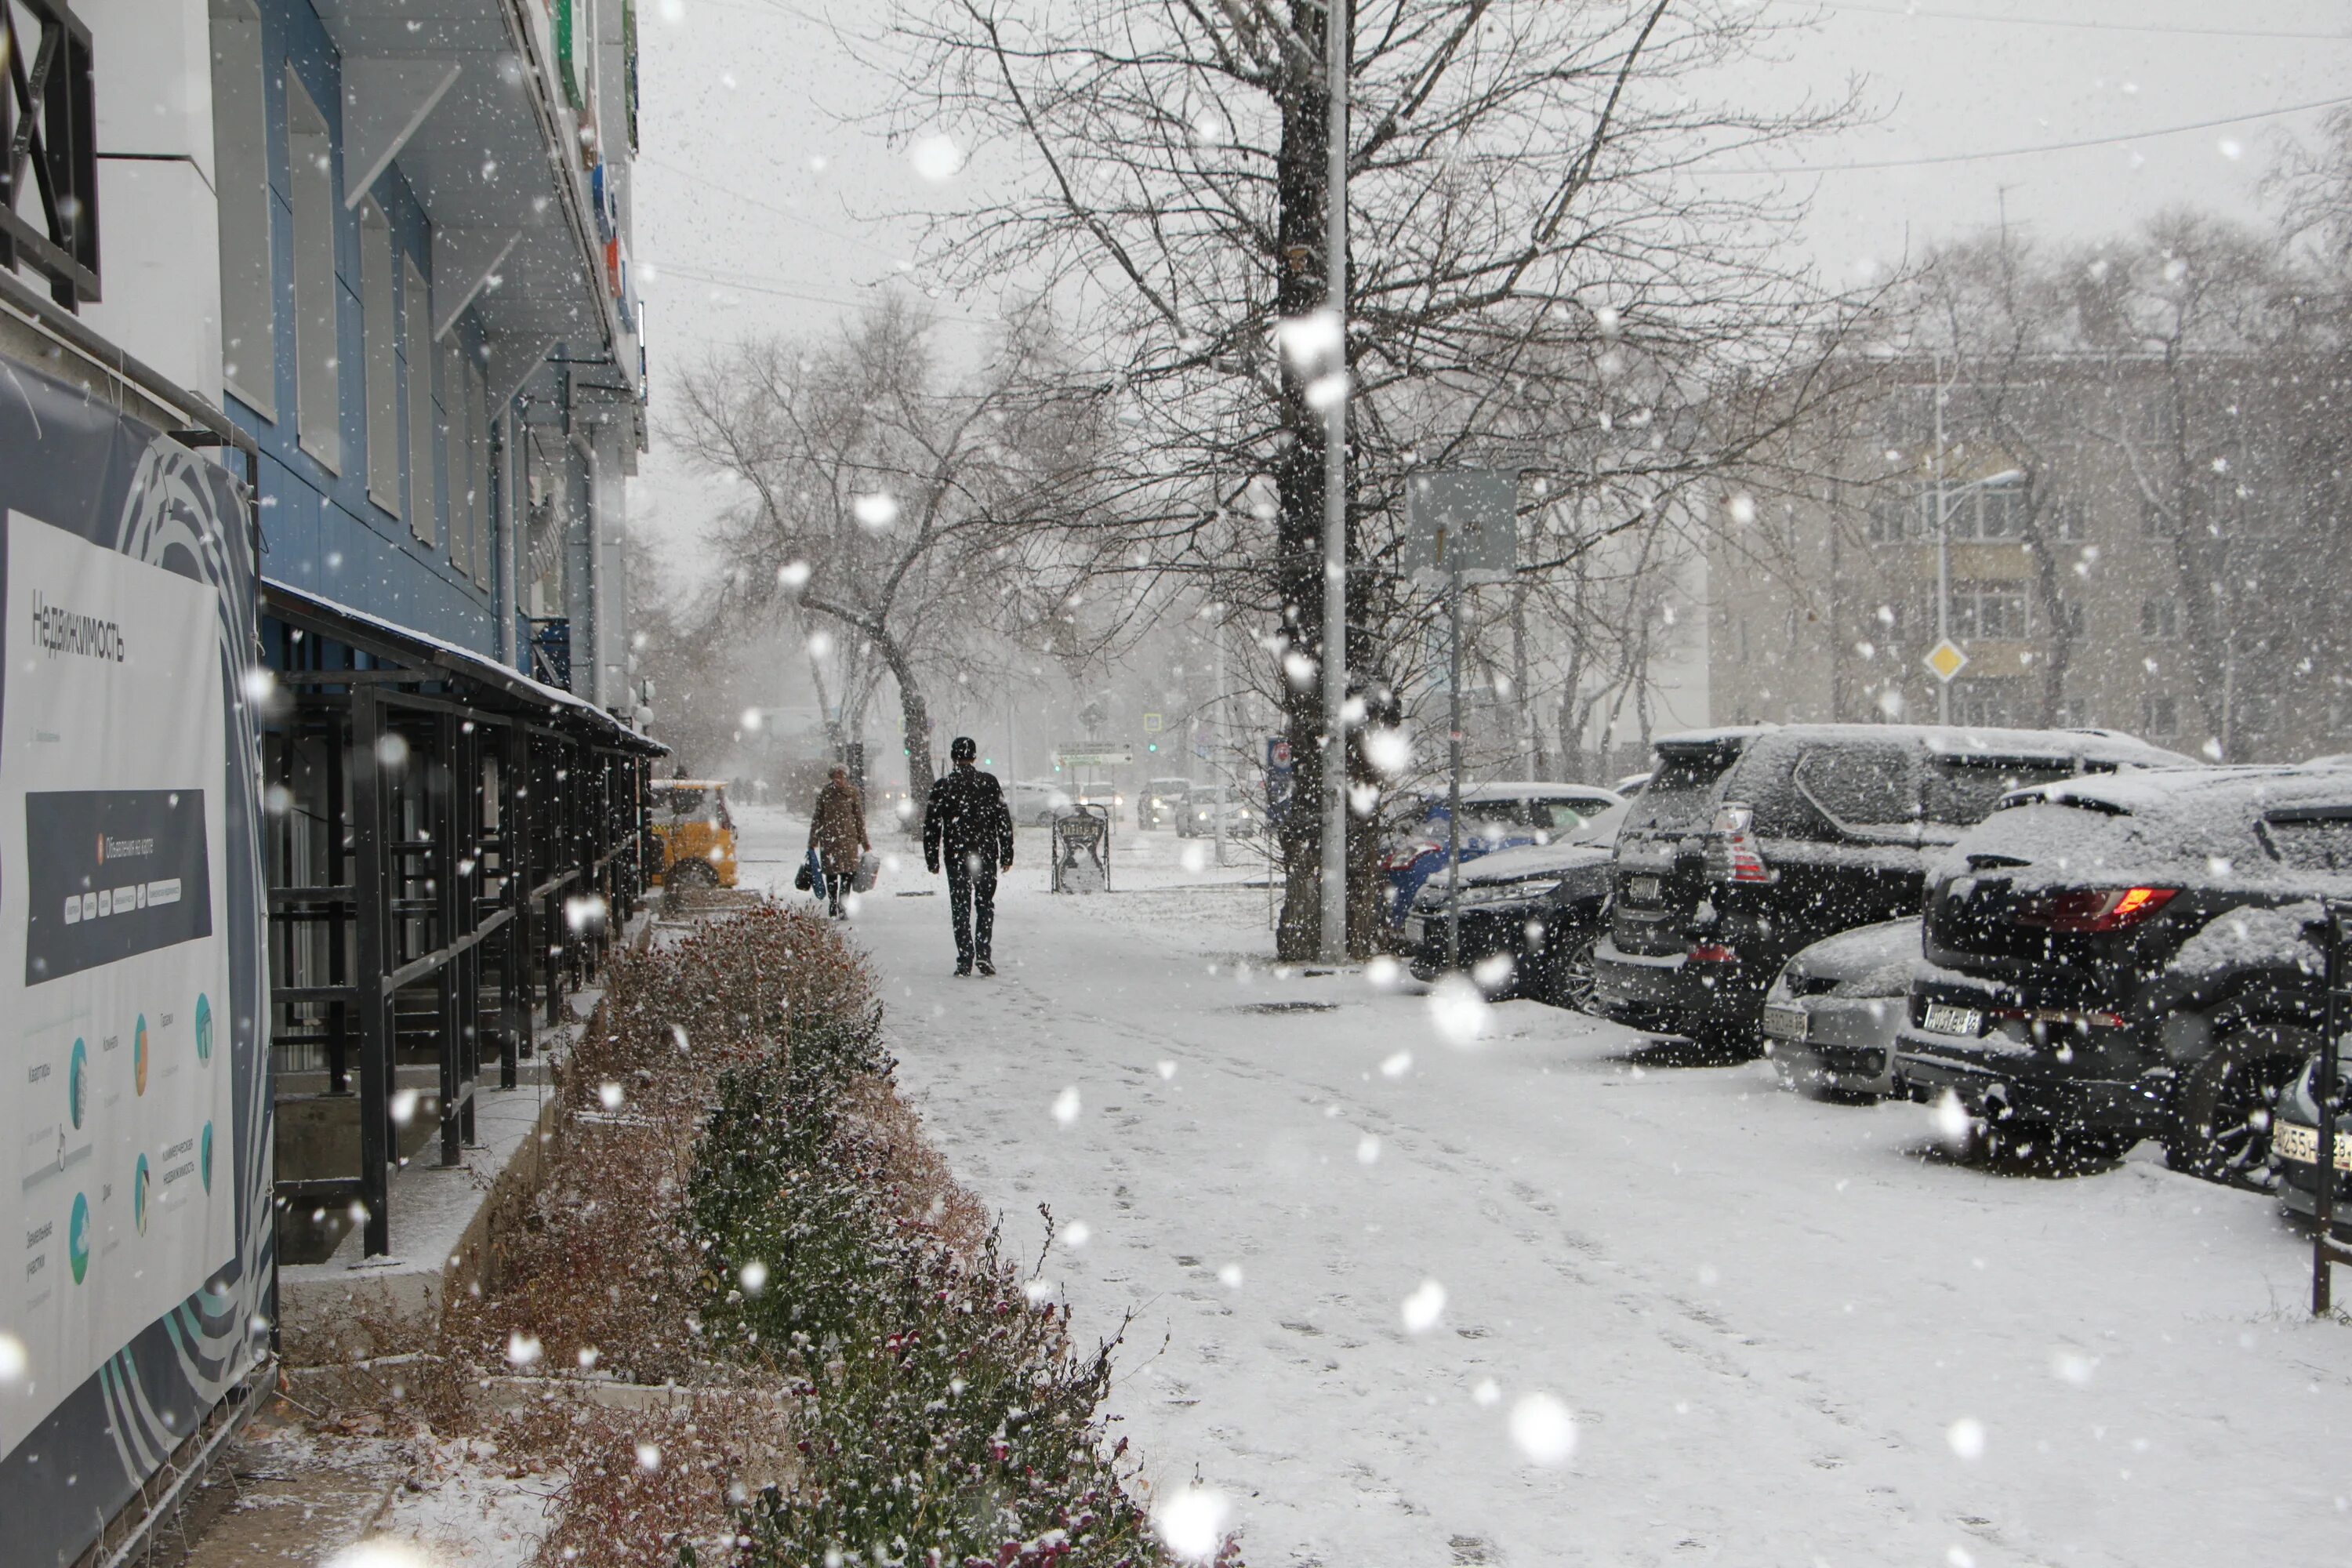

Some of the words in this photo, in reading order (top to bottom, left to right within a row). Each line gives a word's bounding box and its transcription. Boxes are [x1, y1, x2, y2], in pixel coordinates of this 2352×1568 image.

[32, 589, 125, 662] Недвижимость
[28, 1063, 51, 1085] Квартиры
[163, 1161, 194, 1185] недвижимость
[26, 1254, 45, 1283] участки
